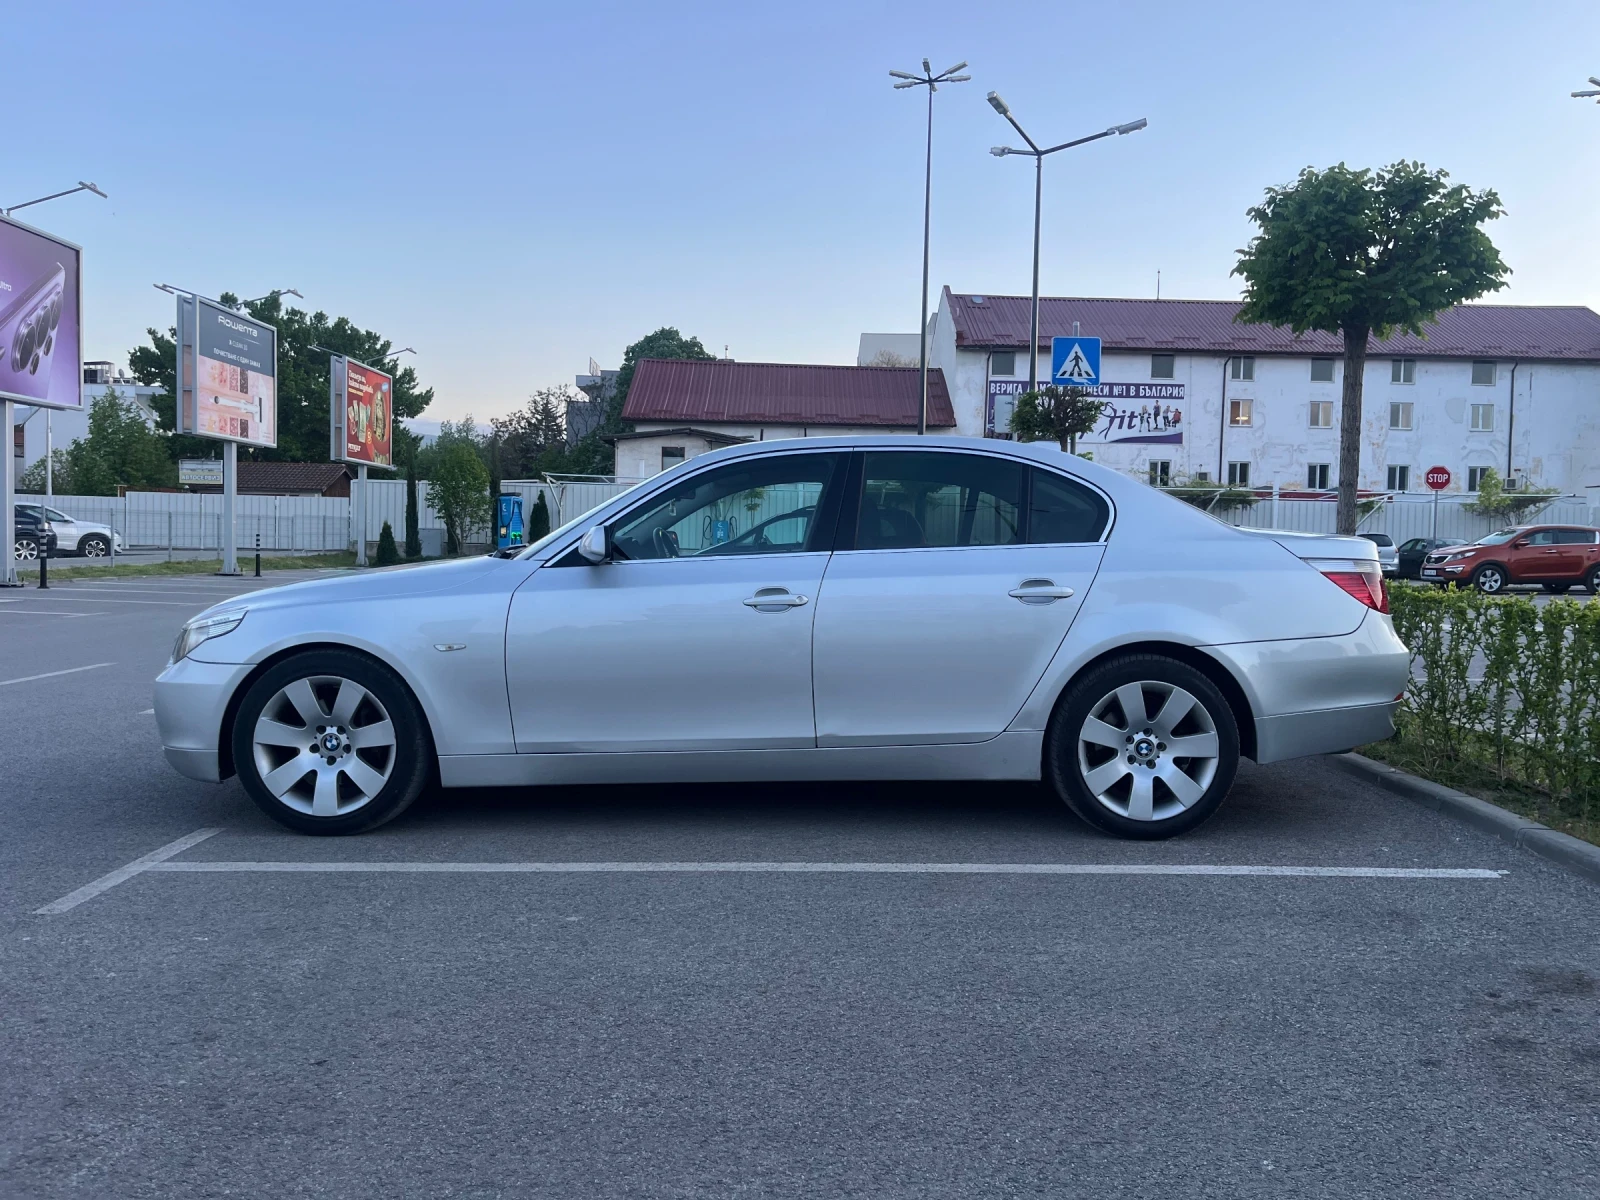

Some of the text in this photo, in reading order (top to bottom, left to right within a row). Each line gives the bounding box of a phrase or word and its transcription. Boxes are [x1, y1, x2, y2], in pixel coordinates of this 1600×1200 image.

[218, 315, 258, 337] Rowenta
[990, 382, 1023, 394] ВЕРИГА
[1113, 385, 1126, 396] №1
[1130, 386, 1136, 396] В
[1139, 386, 1185, 397] БЪЛГАРИЯ
[1428, 473, 1449, 483] STOP
